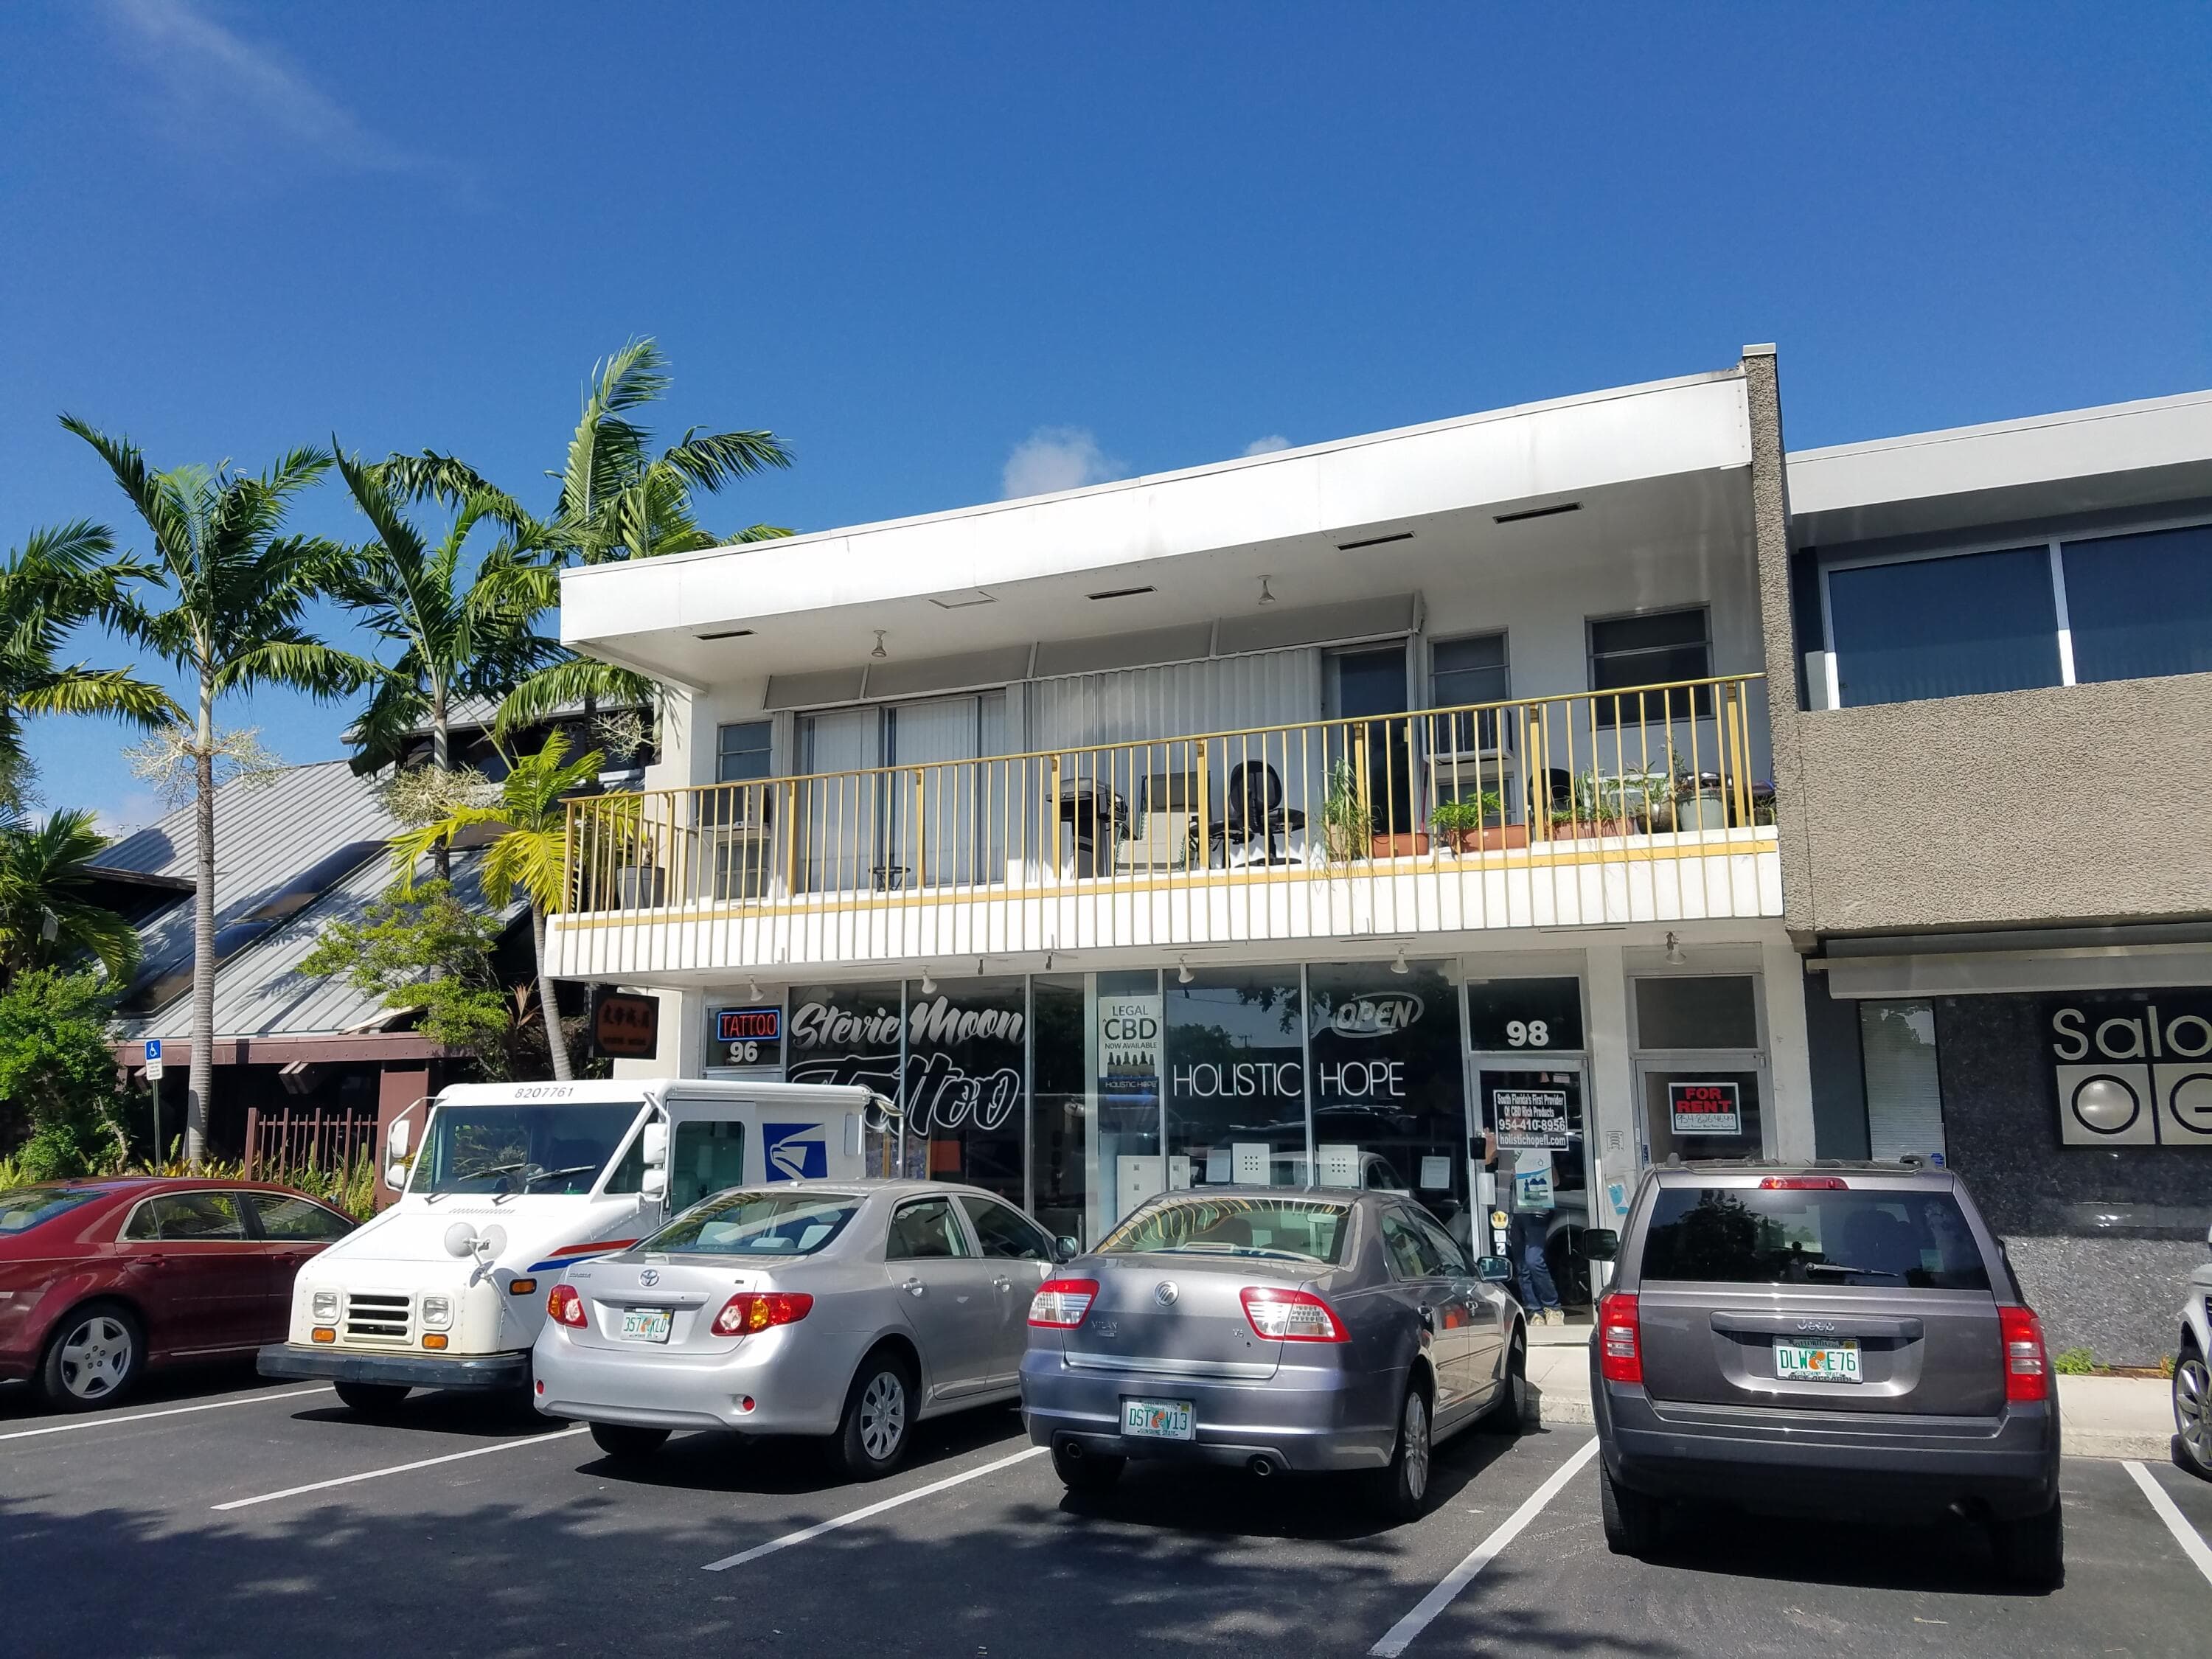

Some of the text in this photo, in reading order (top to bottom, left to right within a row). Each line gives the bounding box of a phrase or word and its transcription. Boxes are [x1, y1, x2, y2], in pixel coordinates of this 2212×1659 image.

[1112, 1005, 1149, 1017] LEGAL
[1336, 1001, 1413, 1029] OPEN
[721, 1014, 776, 1037] TATTOO
[790, 995, 1026, 1049] Stevie Moon
[1105, 1018, 1157, 1040] CBD
[1506, 1020, 1549, 1046] 98
[729, 1041, 758, 1062] 96
[1174, 1062, 1406, 1096] HOLISTIC HOPE
[515, 1087, 574, 1098] 8207761
[1497, 1093, 1564, 1105] South Florida's First Provider
[1686, 1088, 1722, 1099] FOR
[1522, 1107, 1533, 1117] Rich
[1534, 1107, 1554, 1118] Products
[1676, 1100, 1732, 1113] RENT
[1498, 1119, 1565, 1130] 954-410-8956
[1500, 1134, 1566, 1147] holistichopefl.com
